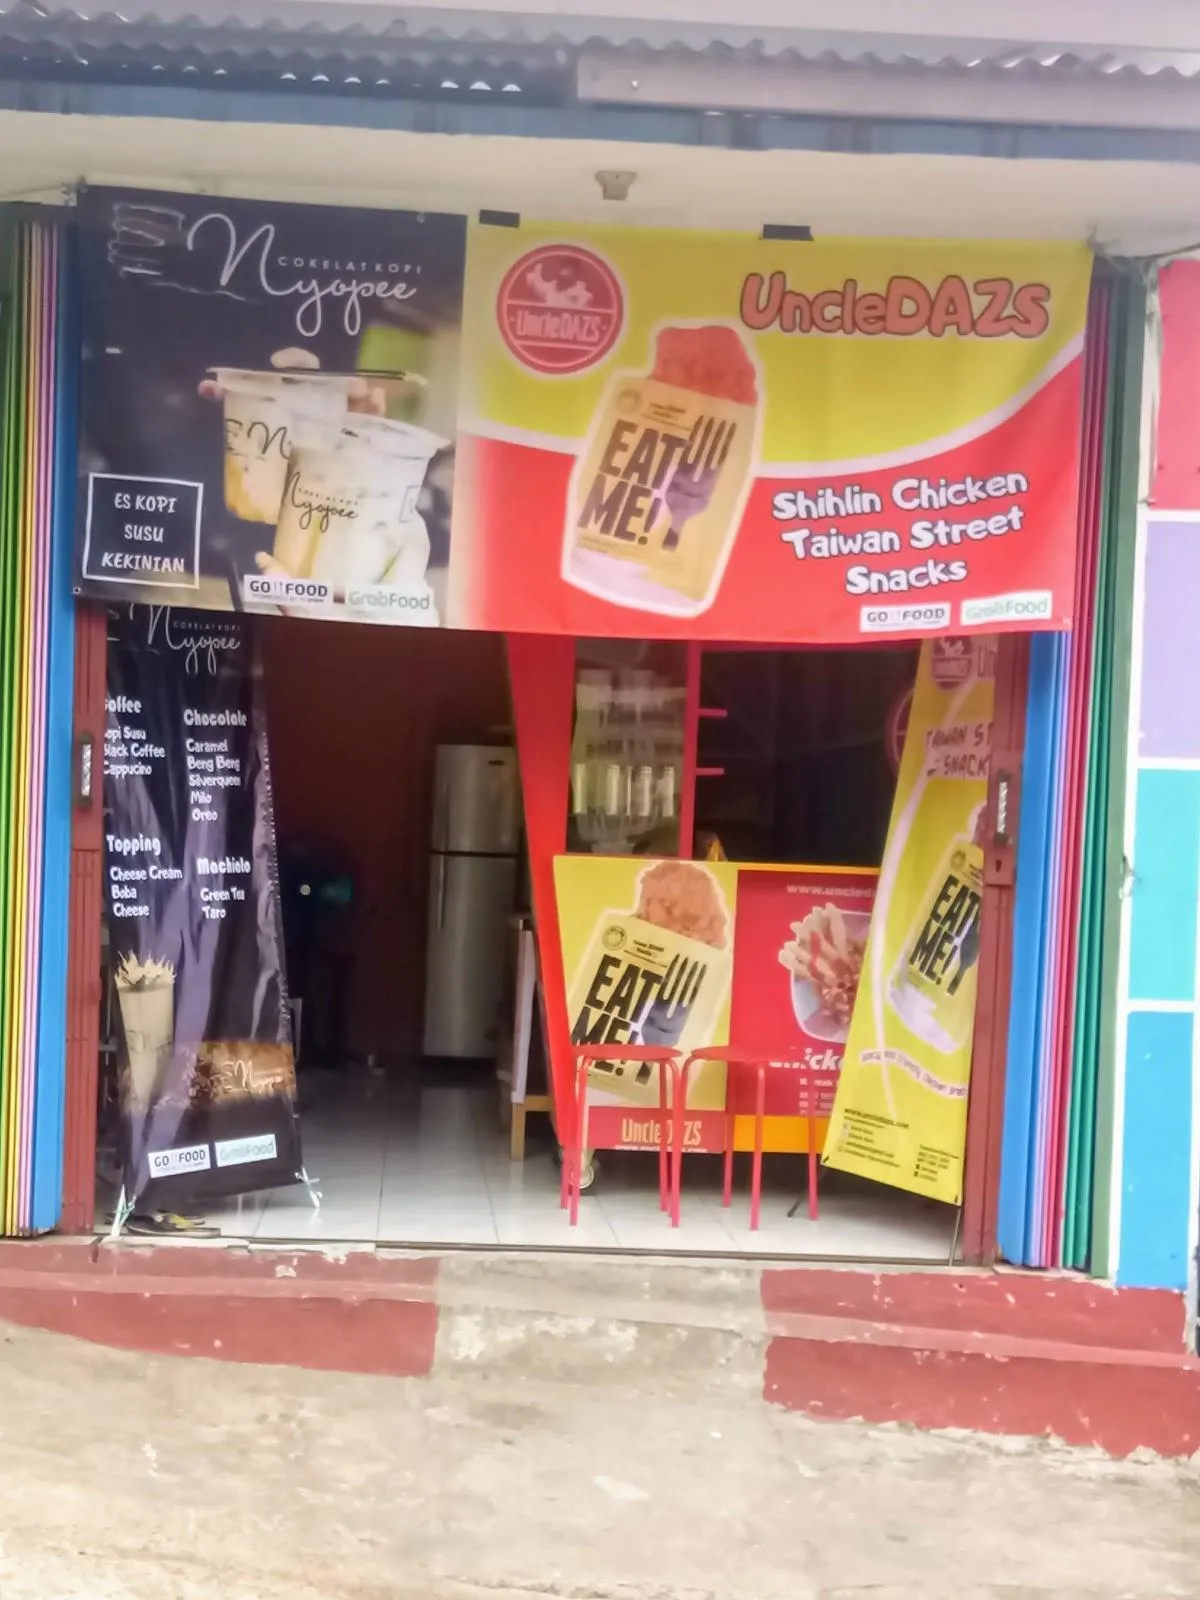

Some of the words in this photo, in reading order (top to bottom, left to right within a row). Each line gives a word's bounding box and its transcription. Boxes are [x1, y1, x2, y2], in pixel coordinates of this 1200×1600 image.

[186, 212, 417, 337] Nyopee
[374, 261, 422, 275] KOPI
[740, 271, 1050, 339] UncleDAZS
[599, 418, 690, 490] EAT
[113, 493, 132, 510] ES
[135, 495, 178, 514] KOPI
[771, 484, 883, 521] Shihlin
[891, 471, 1029, 511] Chicken
[577, 473, 663, 546] ME!
[123, 524, 165, 544] SUSU
[780, 527, 902, 560] Taiwan
[909, 505, 1025, 550] Street
[101, 551, 186, 574] KEKINIAN
[845, 558, 968, 596] Snacks
[349, 590, 431, 611] GrabFood
[104, 695, 142, 714] offee
[183, 709, 248, 727] Chocolate
[103, 726, 122, 742] opi
[123, 726, 147, 740] Susu
[131, 744, 166, 758] Coffee
[185, 738, 229, 753] Caramel
[186, 756, 214, 772] Beng
[216, 756, 241, 772] Beng
[189, 790, 213, 805] Milo
[191, 808, 218, 822] Oreo
[105, 833, 162, 857] Topping
[109, 866, 148, 882] Cheese
[149, 866, 183, 880] Cream
[111, 885, 137, 900] Boba
[199, 888, 230, 902] Green
[112, 902, 150, 918] Cheese
[201, 905, 227, 920] Taro
[585, 953, 664, 1024] EAT
